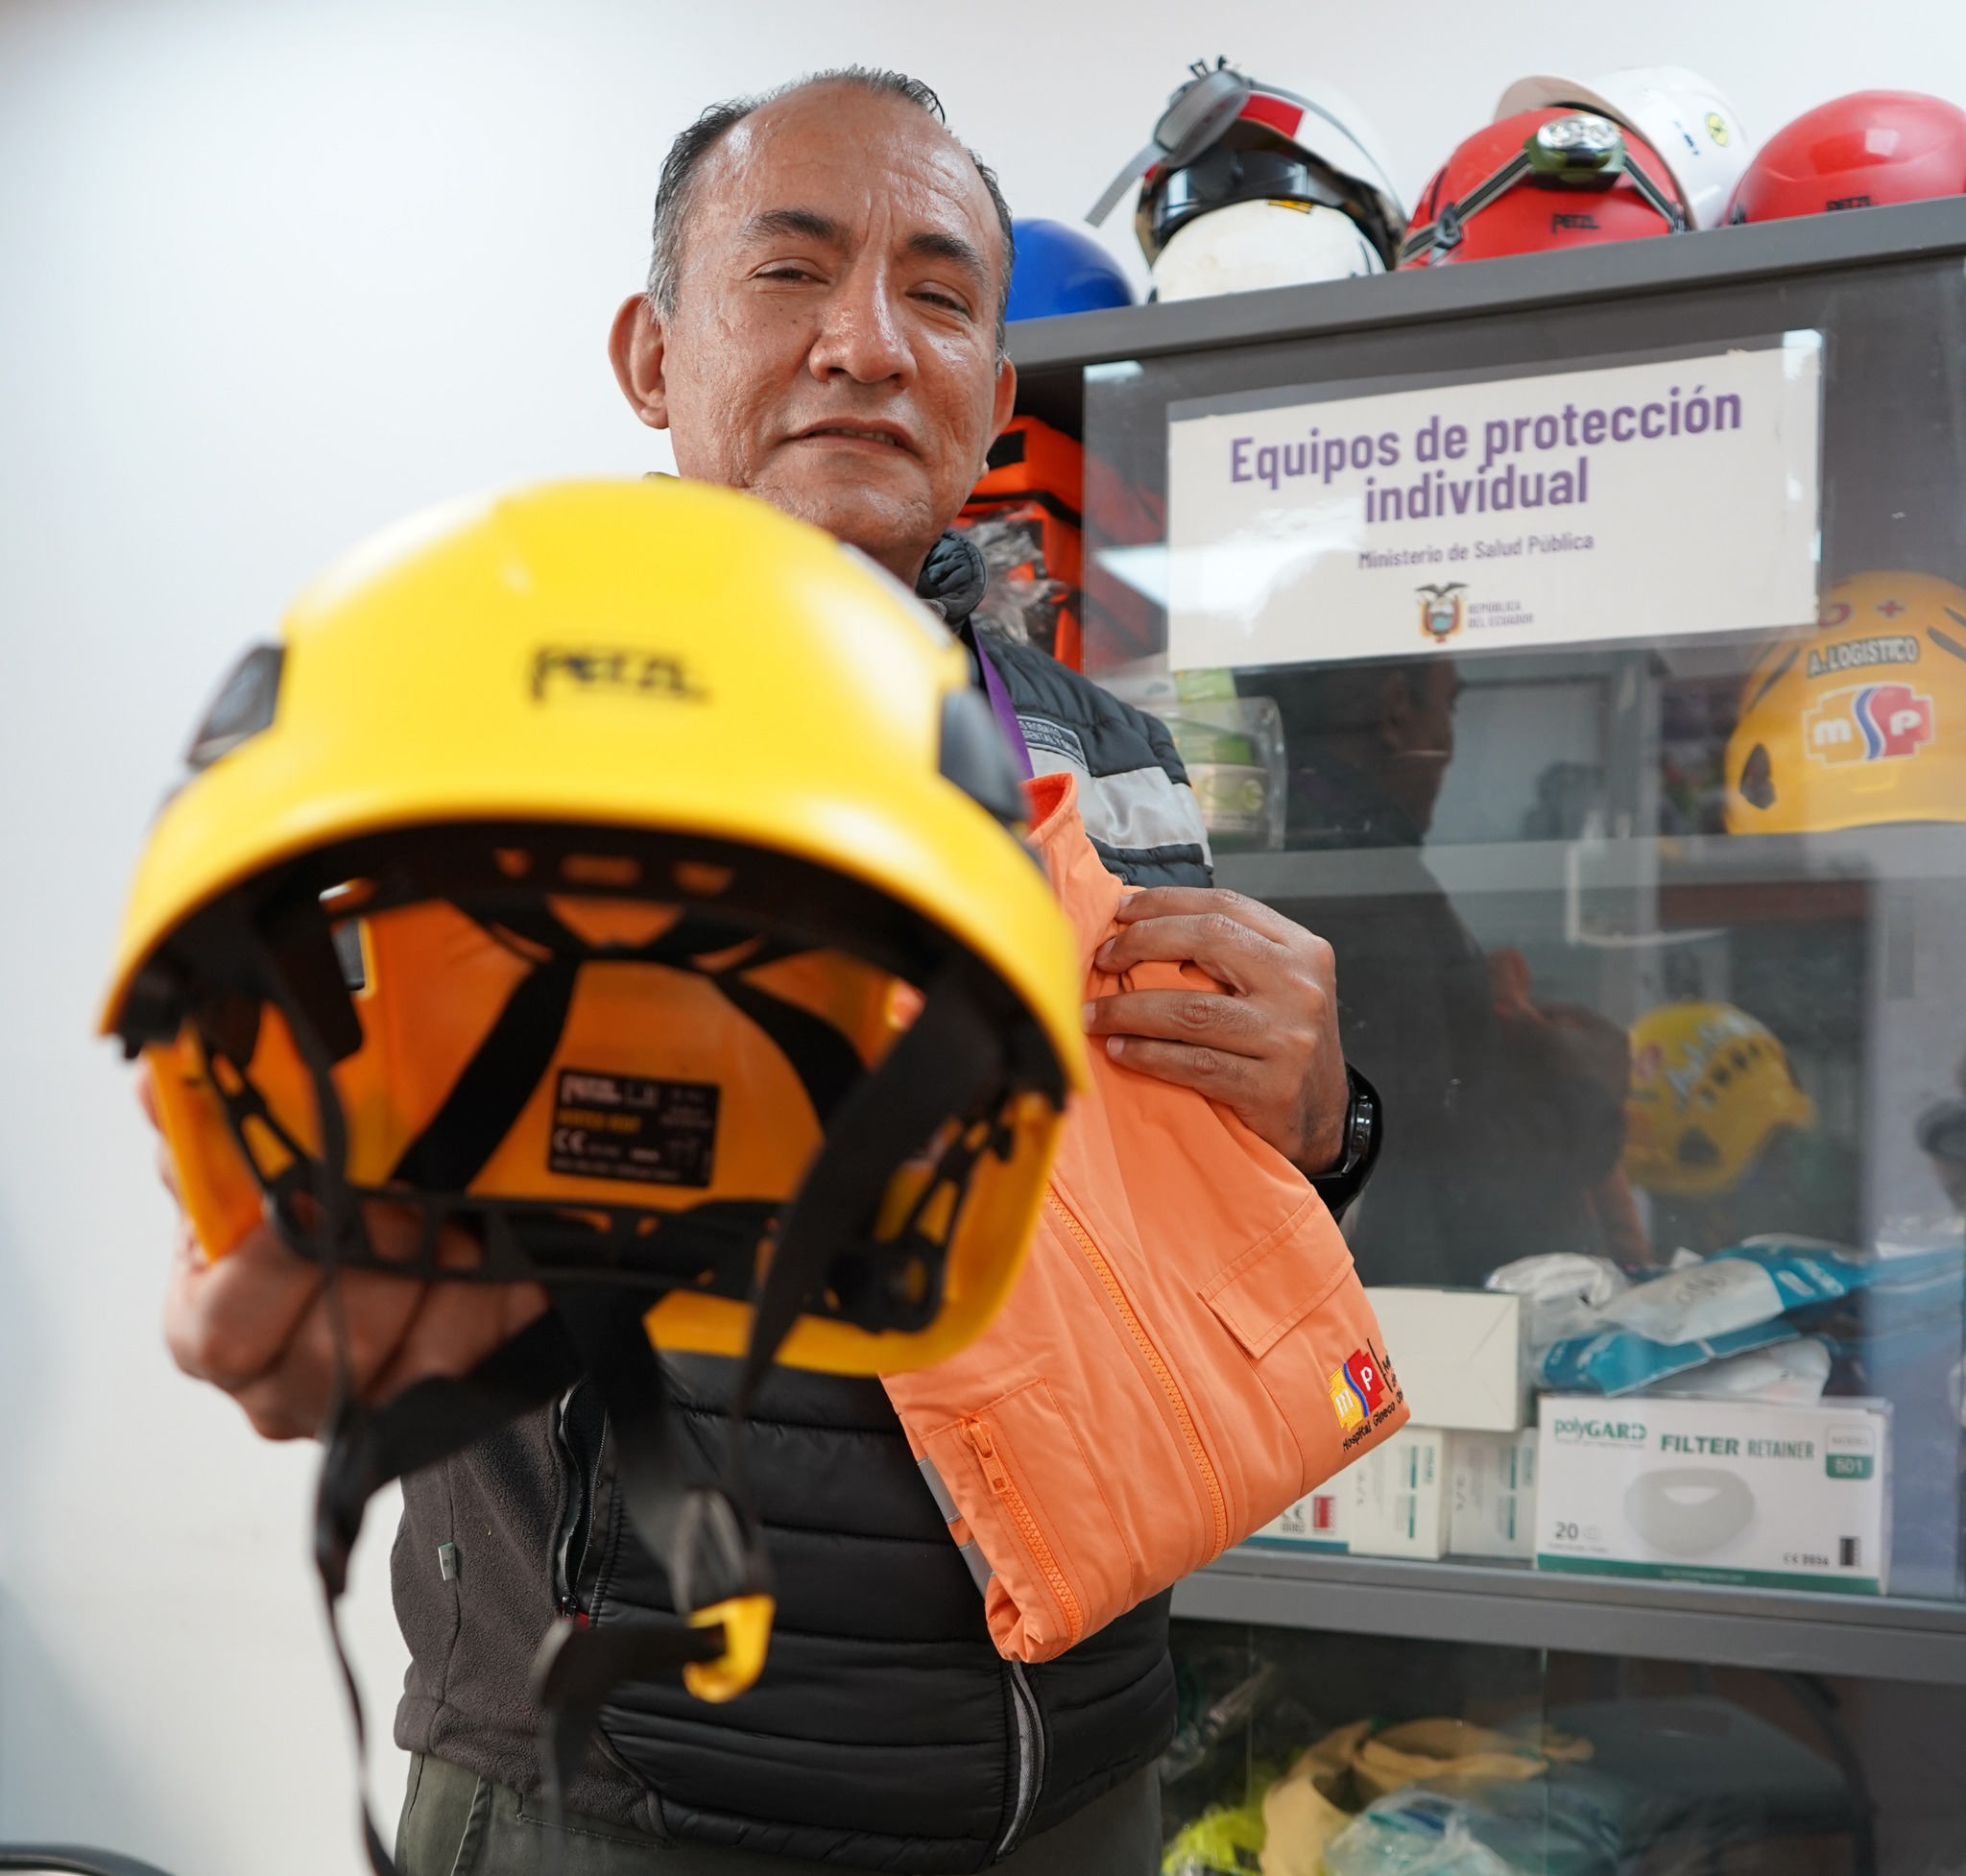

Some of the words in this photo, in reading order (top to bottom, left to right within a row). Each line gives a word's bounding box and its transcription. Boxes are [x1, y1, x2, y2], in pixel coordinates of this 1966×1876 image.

[1231, 426, 1401, 491] Equipos
[1414, 414, 1469, 464] de
[1484, 384, 1742, 469] protección
[1366, 455, 1588, 523] individual
[1357, 544, 1443, 569] Ministerio
[1448, 542, 1469, 562] de
[1473, 538, 1522, 560] Salud
[1527, 531, 1594, 554] Pública
[1807, 635, 1920, 678] A.LOGISTICO
[1342, 1420, 1372, 1453] Hospital
[1373, 1402, 1396, 1427] Gineco
[1661, 1434, 1740, 1456] FILTER
[1747, 1439, 1815, 1460] RETAINER
[1555, 1522, 1579, 1542] 20
